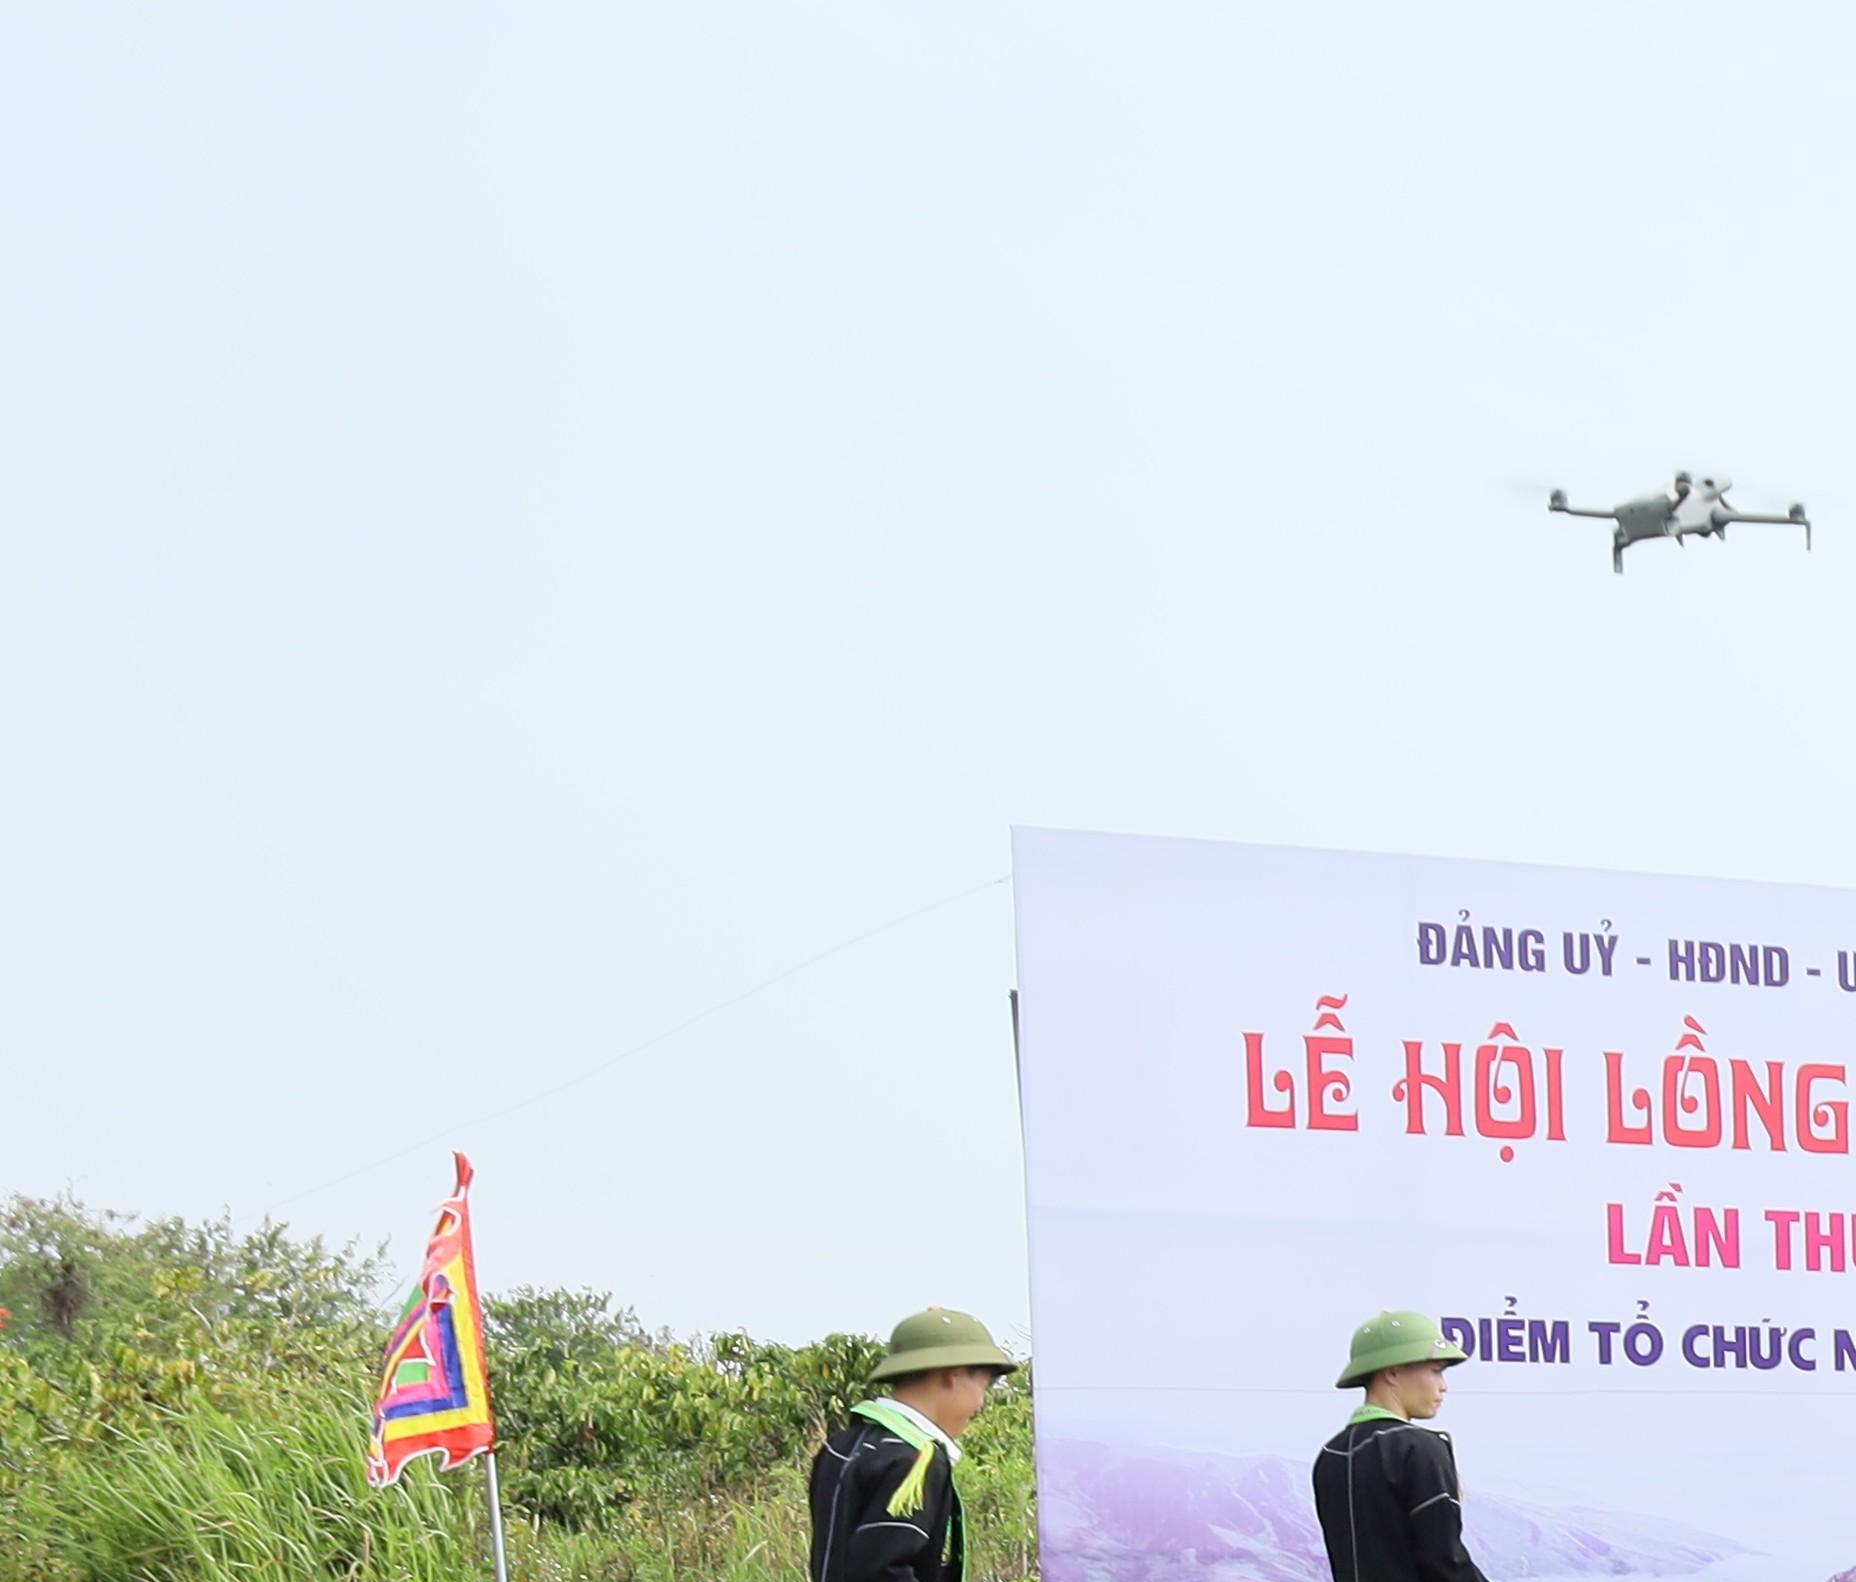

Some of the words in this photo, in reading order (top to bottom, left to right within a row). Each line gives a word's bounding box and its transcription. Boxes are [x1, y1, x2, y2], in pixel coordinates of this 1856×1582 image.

[1415, 908, 1547, 973] ĐẢNG
[1562, 917, 1620, 977] UỶ
[1667, 938, 1791, 988] HĐND
[1241, 993, 1360, 1133] LỄ
[1391, 1021, 1568, 1164] HỘI
[1602, 1014, 1850, 1156] LỒNG
[1605, 1182, 1742, 1270] LẦN
[1439, 1295, 1572, 1365] ĐIỂM
[1586, 1299, 1665, 1367] TỔ
[1680, 1315, 1818, 1373] CHỨC
